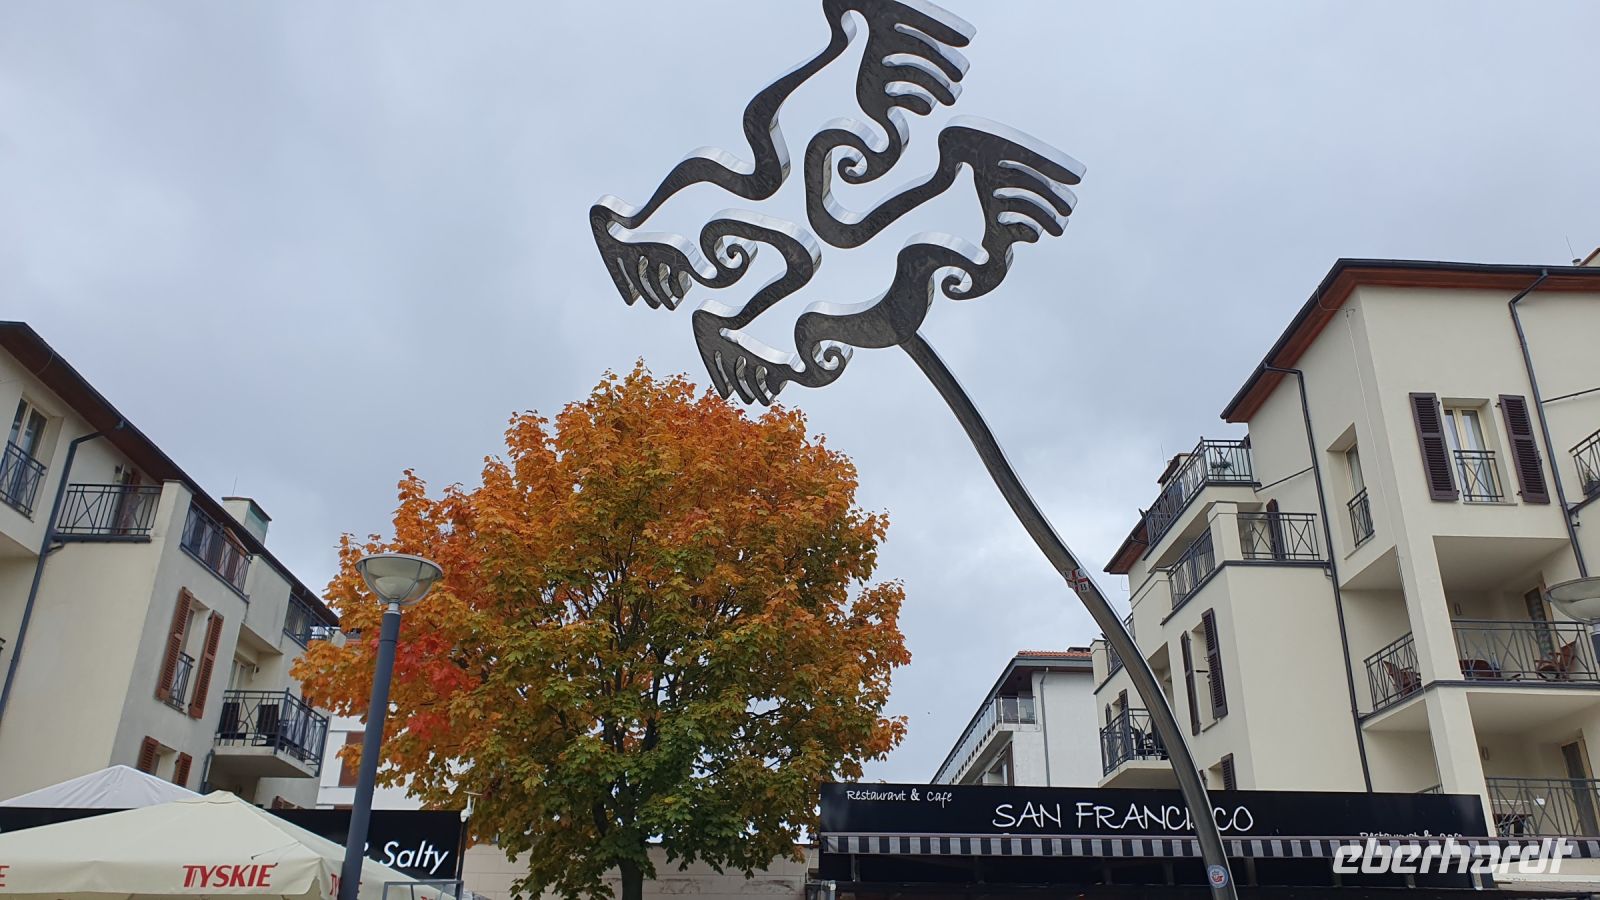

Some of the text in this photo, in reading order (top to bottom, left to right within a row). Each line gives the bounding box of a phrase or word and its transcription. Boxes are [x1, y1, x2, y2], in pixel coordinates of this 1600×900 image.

[846, 789, 906, 801] Restaurant
[910, 788, 921, 801] &
[992, 802, 1254, 831] SAN FRANCICO
[379, 840, 449, 875] Salty
[182, 862, 279, 888] TYSKIE
